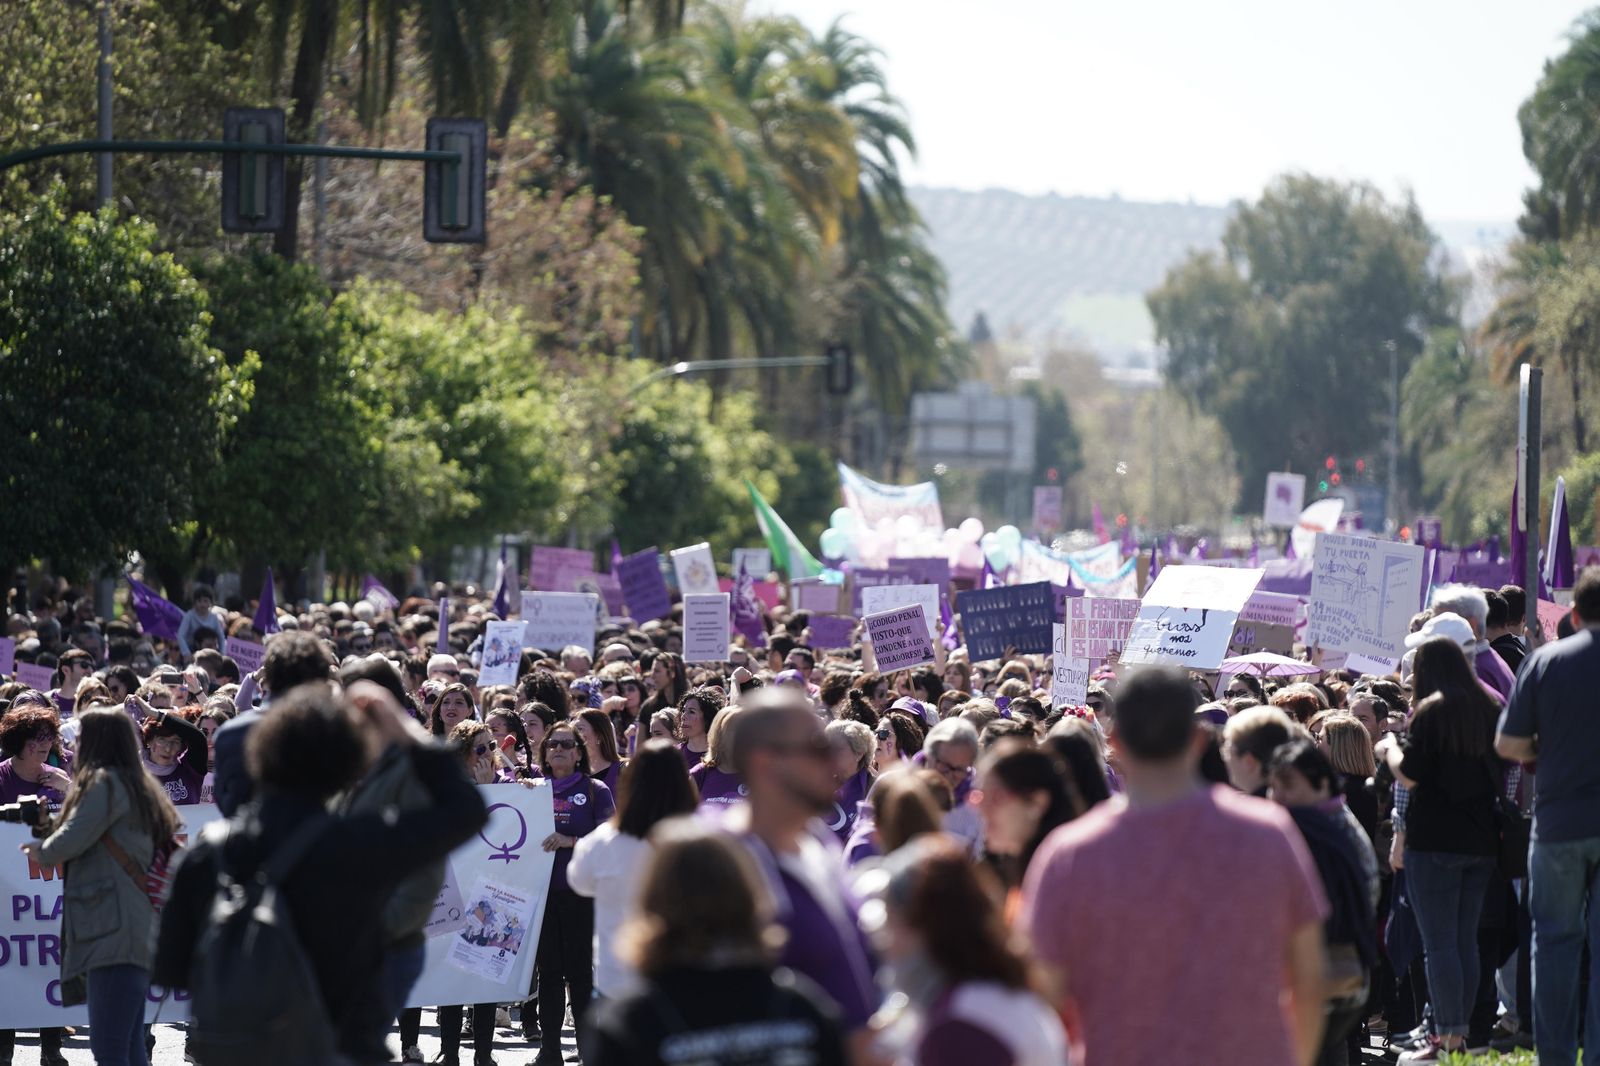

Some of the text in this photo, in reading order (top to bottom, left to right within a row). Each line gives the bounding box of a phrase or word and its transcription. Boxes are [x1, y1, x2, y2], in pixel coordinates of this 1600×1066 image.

[1351, 538, 1377, 550] DIBUJA
[1324, 547, 1370, 560] TU PUERTA
[897, 609, 921, 622] PENAL
[1071, 599, 1086, 618] EL
[871, 625, 912, 643] JUSTO-QUE
[1071, 619, 1086, 639] NO
[874, 639, 908, 655] CONDENE
[913, 637, 925, 646] LOS
[1169, 634, 1193, 643] nos
[1321, 634, 1342, 646] 2020
[1357, 632, 1396, 652] VIOLENCIA
[1071, 640, 1086, 657] ES
[1143, 644, 1200, 659] queremos
[877, 649, 922, 666] VIOLADORES!!
